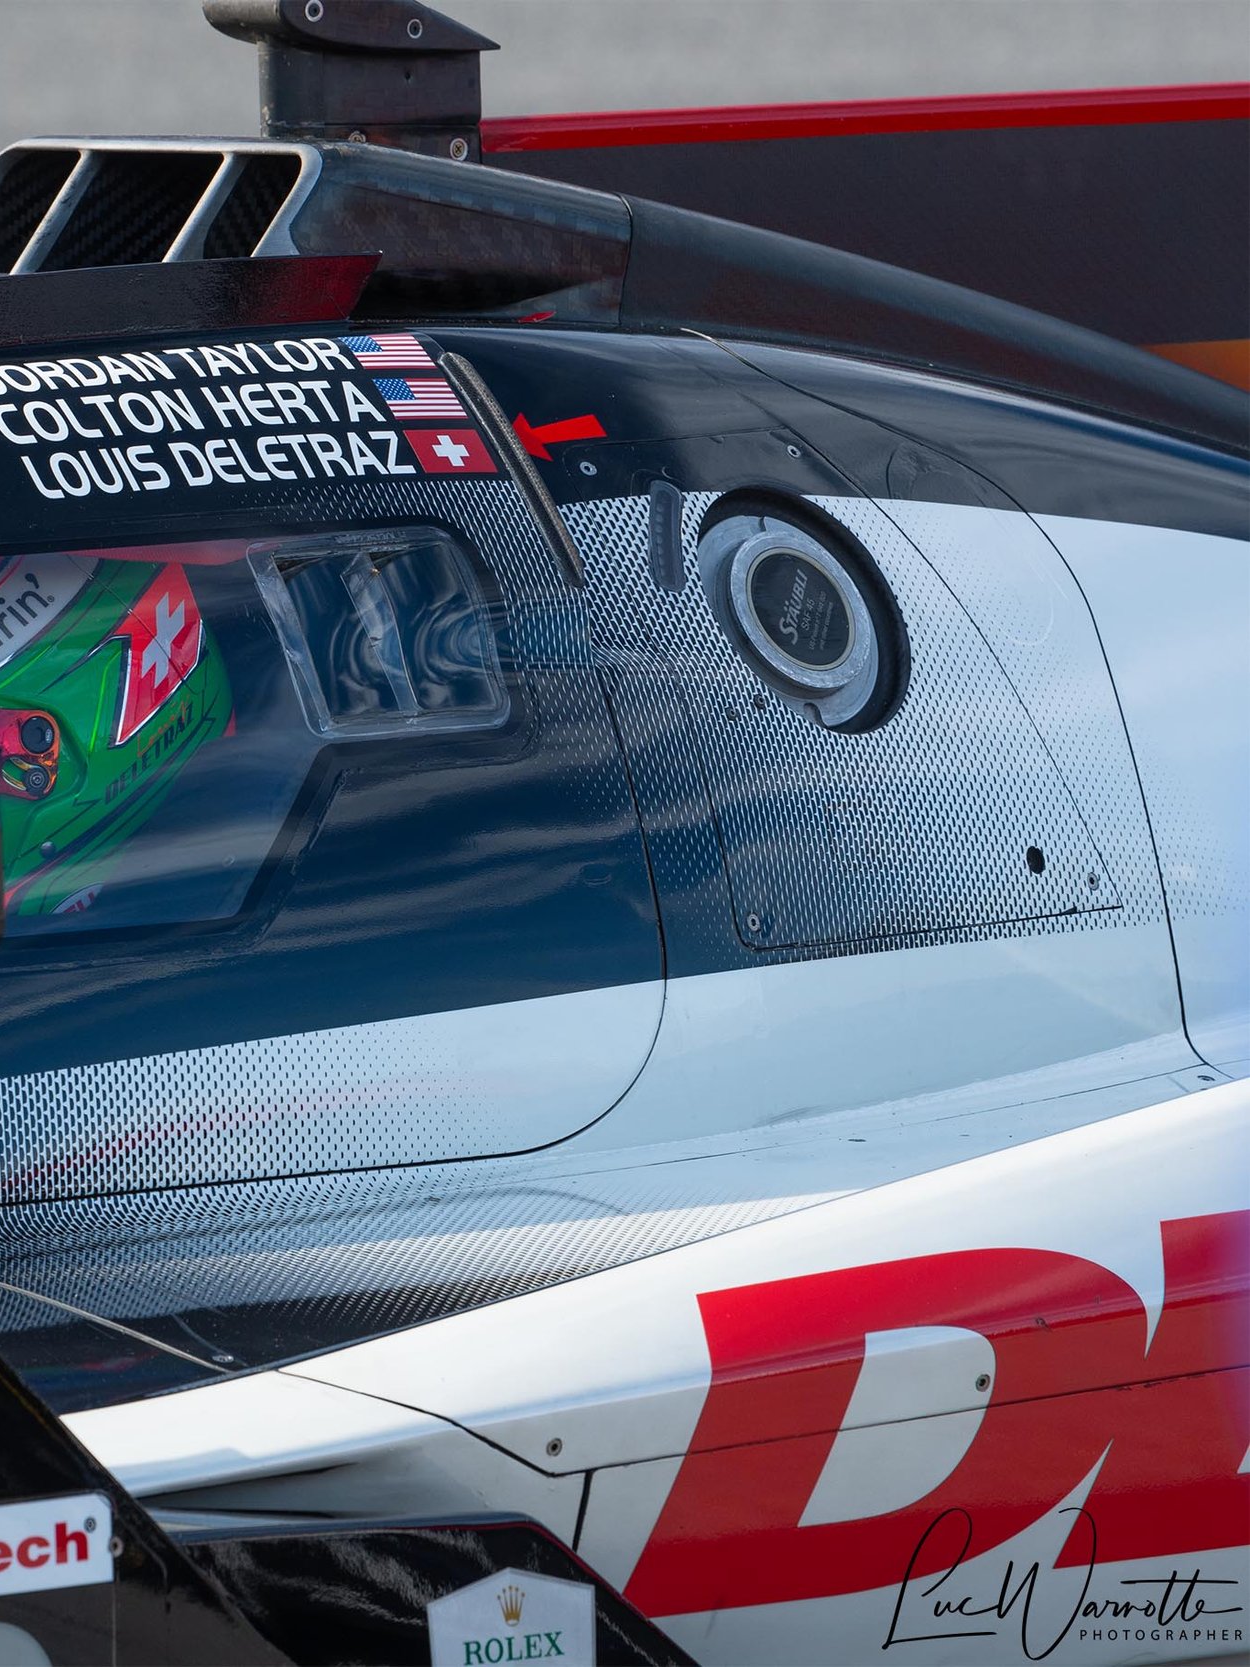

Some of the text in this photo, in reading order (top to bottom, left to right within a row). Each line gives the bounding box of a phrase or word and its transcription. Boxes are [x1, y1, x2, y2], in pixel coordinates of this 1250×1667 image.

[163, 337, 356, 381] TAYLOR
[21, 430, 418, 499] LOUIS DELETRAZ
[462, 1631, 565, 1666] ROLEX
